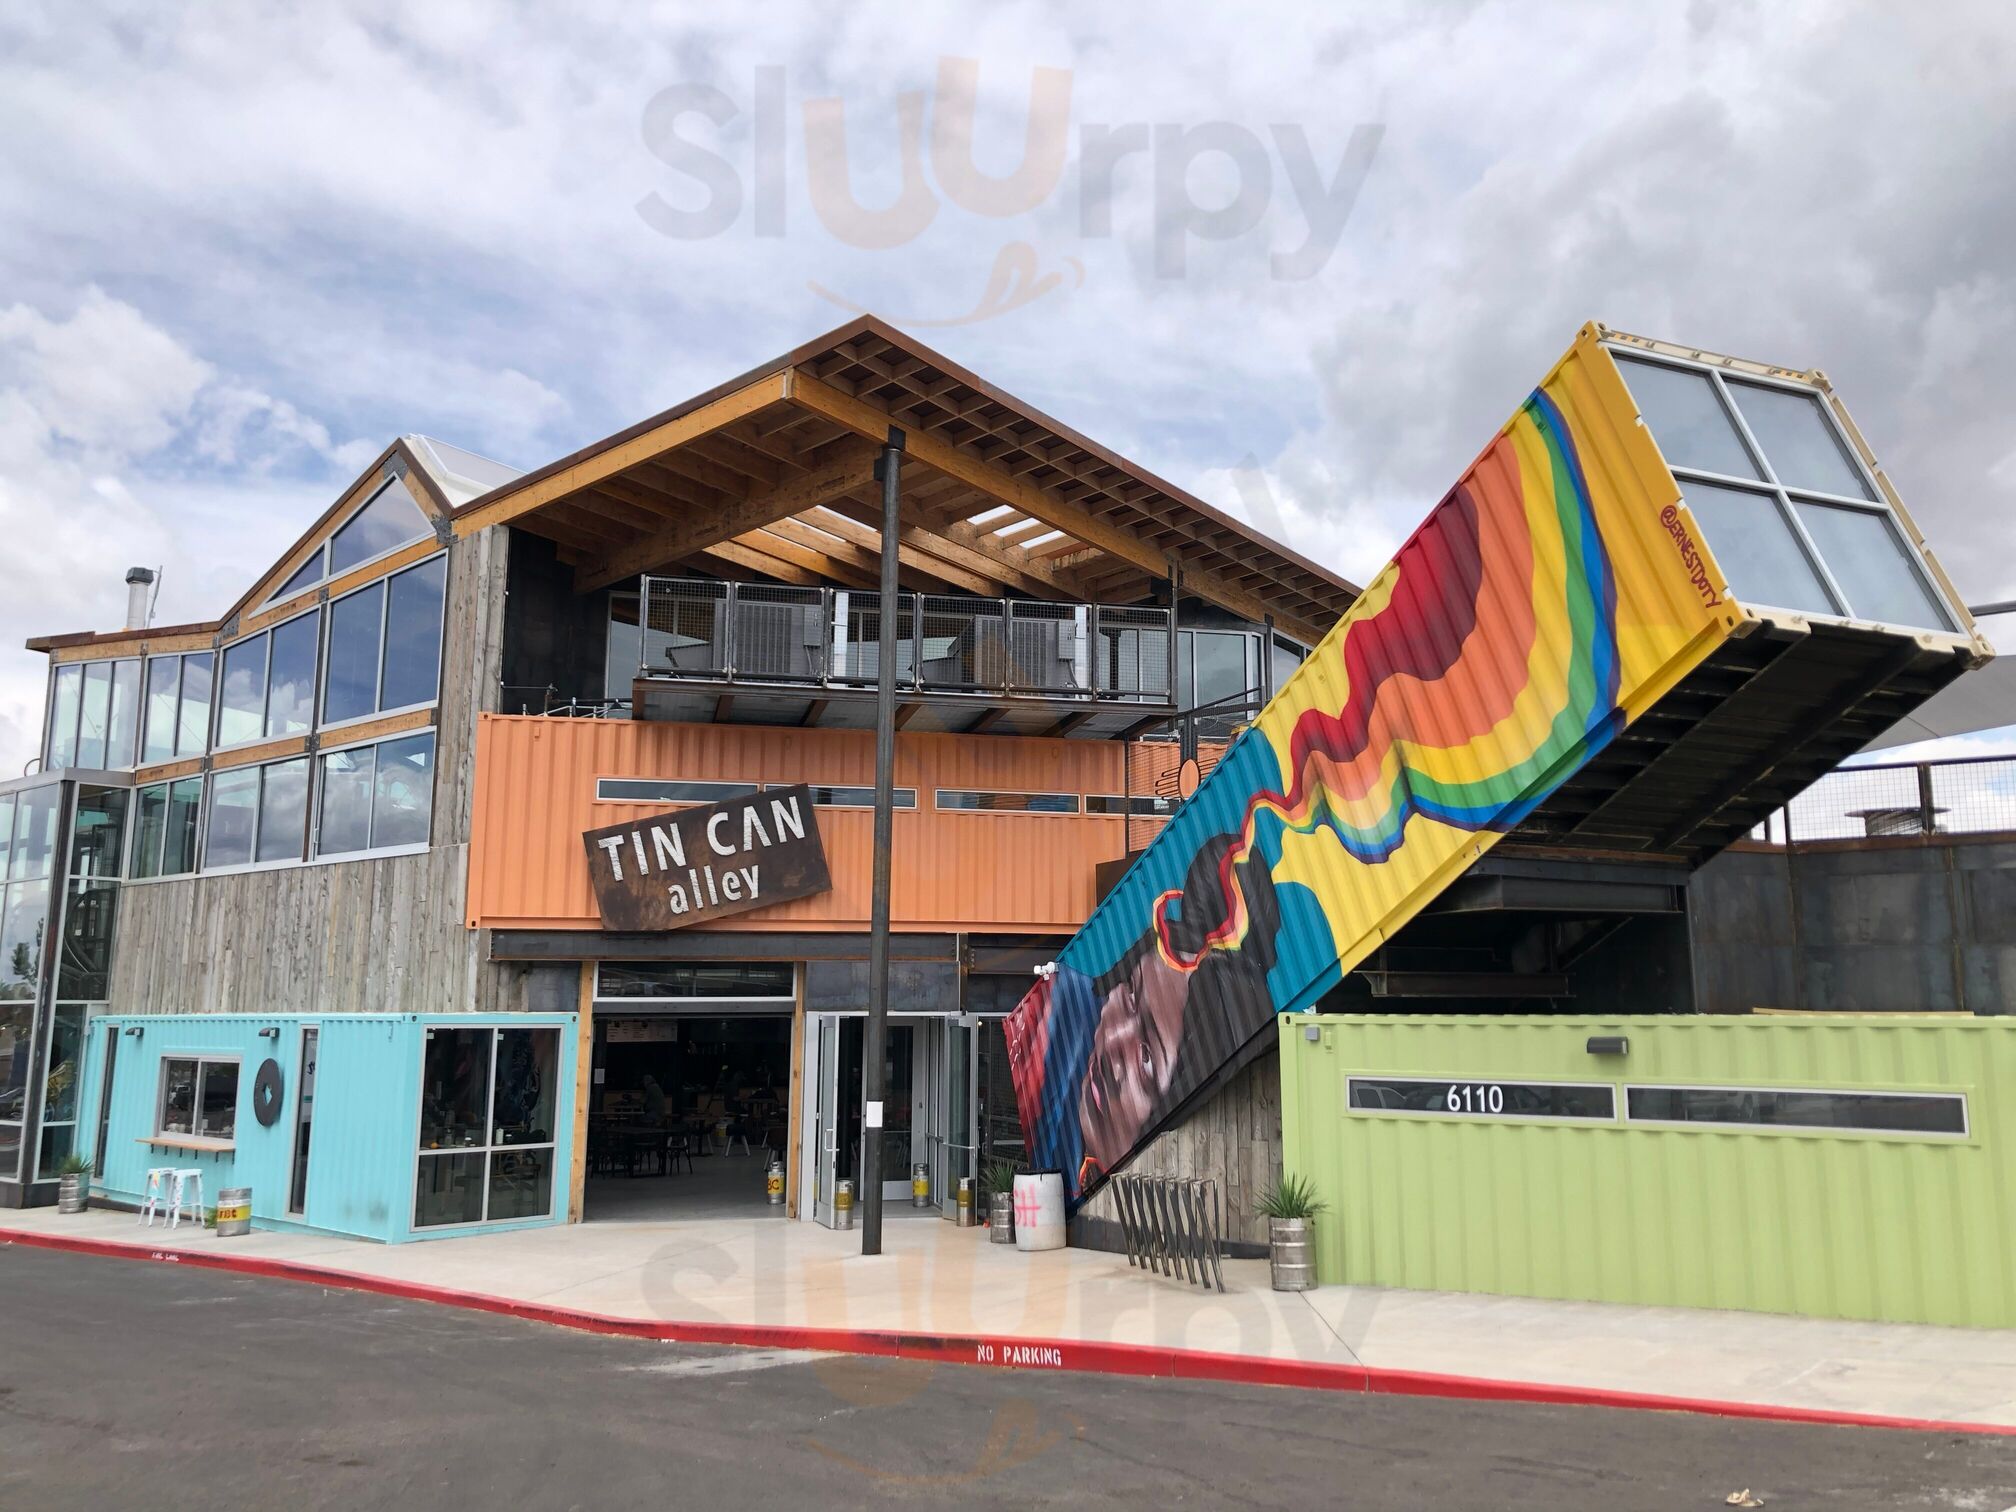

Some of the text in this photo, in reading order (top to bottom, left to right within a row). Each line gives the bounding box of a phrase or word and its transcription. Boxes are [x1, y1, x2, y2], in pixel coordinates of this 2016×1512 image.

[598, 796, 805, 881] TIN CAN
[668, 864, 759, 915] alley
[1447, 1085, 1503, 1113] 6110
[977, 1344, 1062, 1366] NO PARKING
